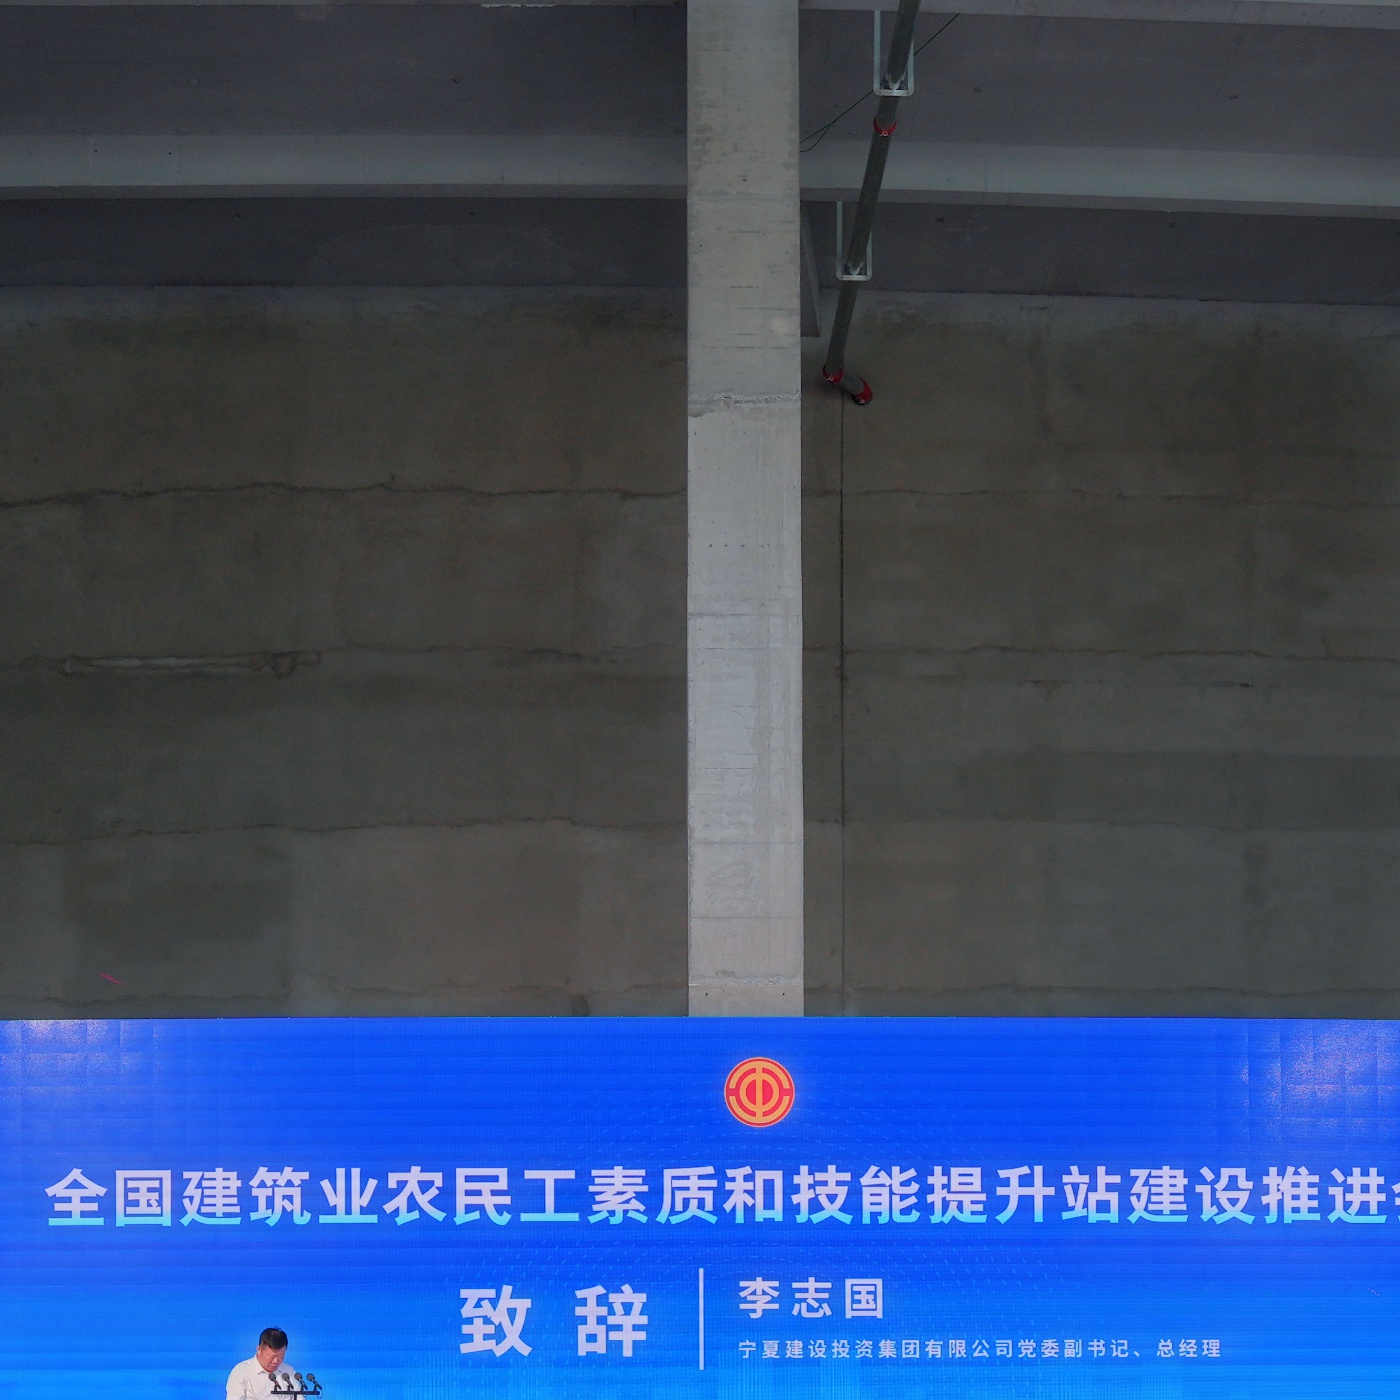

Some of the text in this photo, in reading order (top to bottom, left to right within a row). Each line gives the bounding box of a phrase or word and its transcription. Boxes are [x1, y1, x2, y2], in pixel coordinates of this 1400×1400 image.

[737, 1278, 885, 1319] 李志国
[737, 1339, 1223, 1361] 宁夏建设投资集团有限公司党委副书记、总经理
